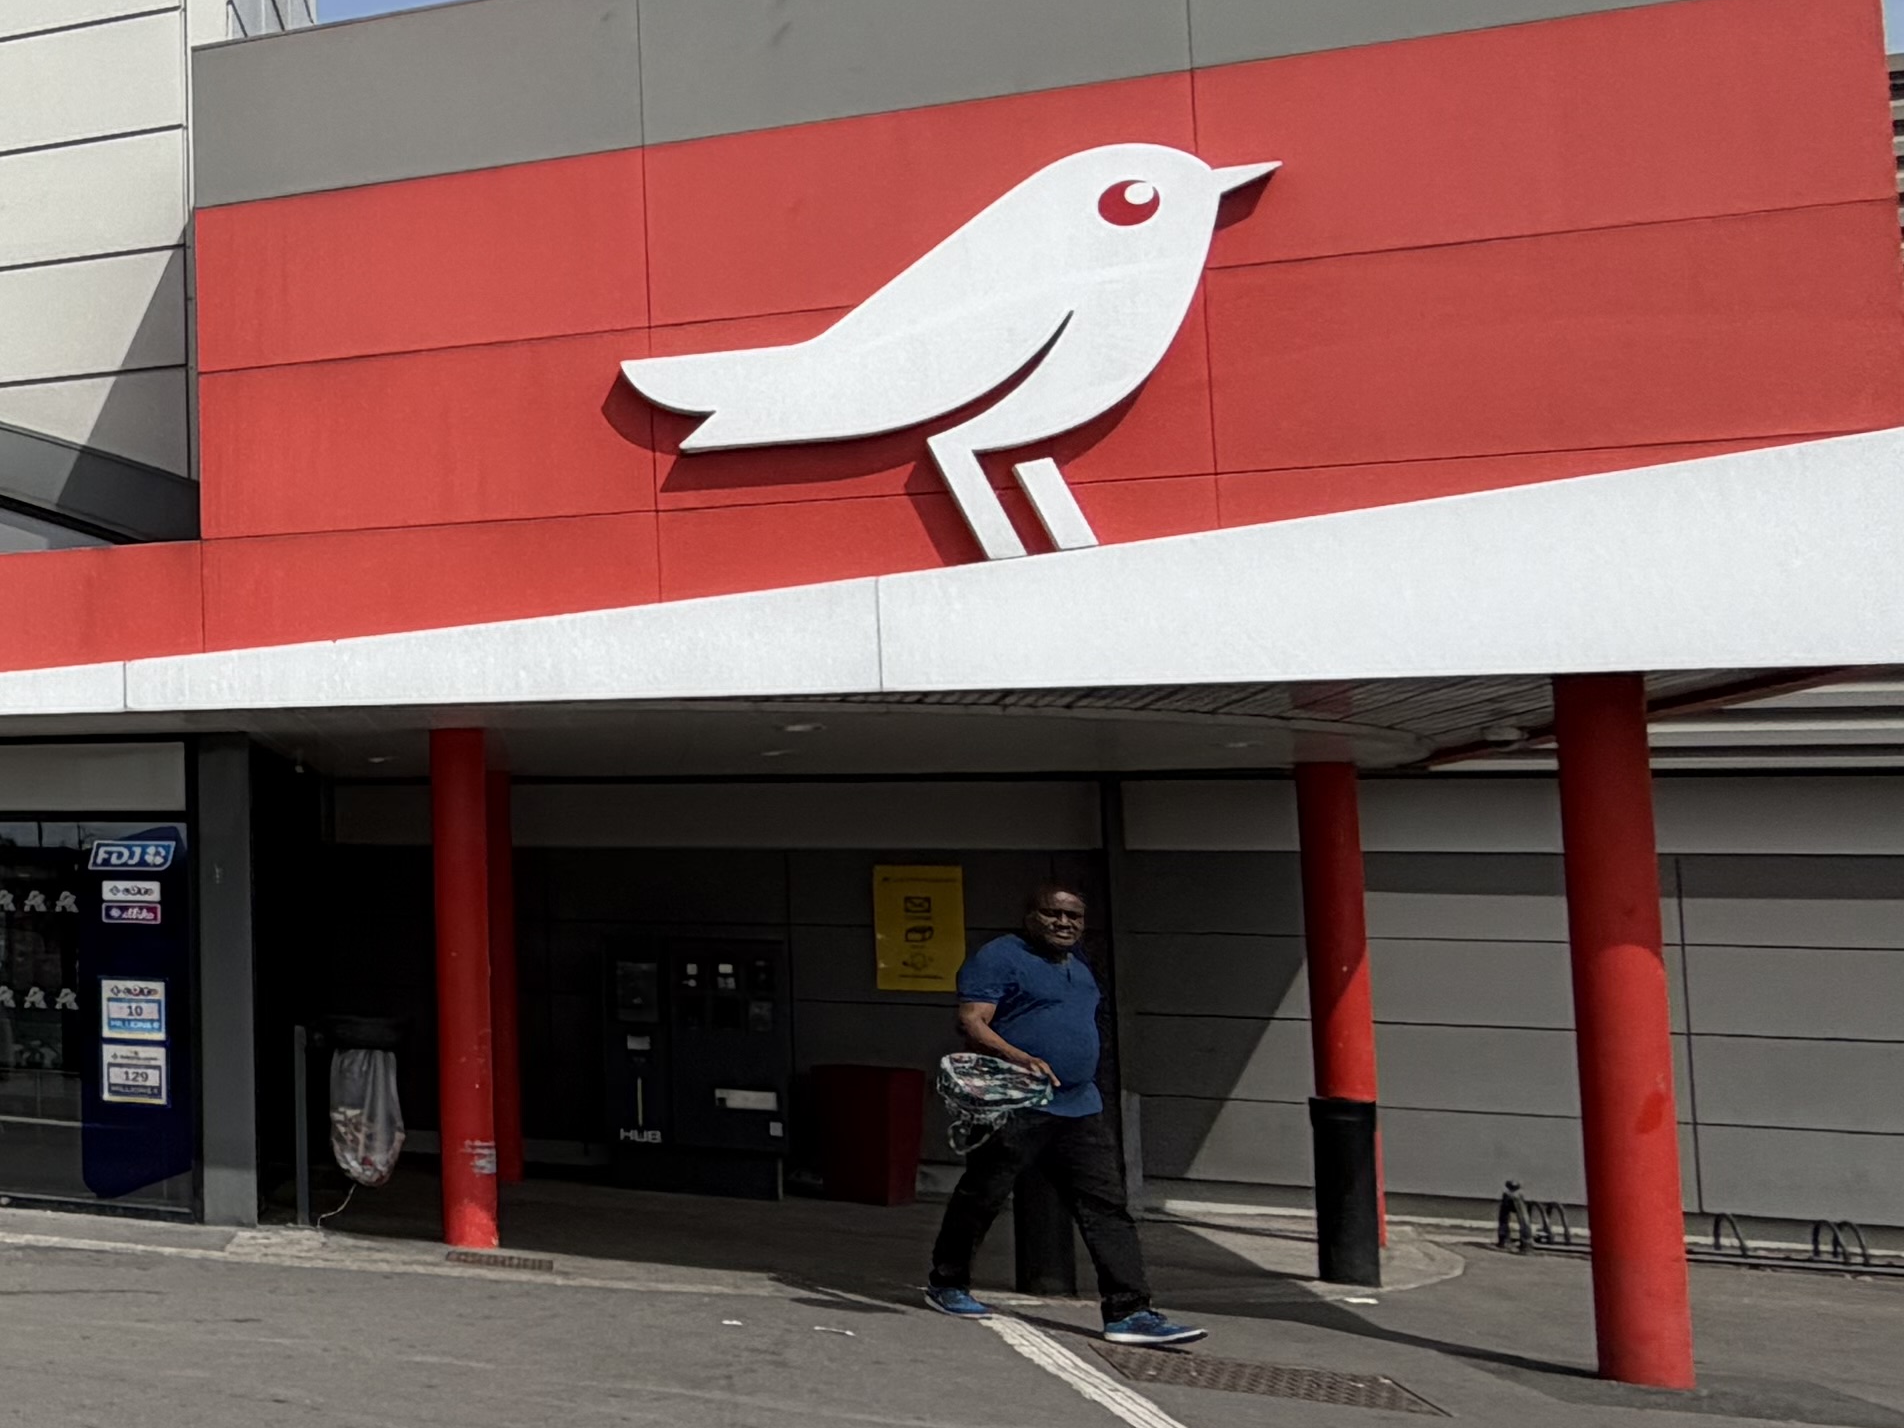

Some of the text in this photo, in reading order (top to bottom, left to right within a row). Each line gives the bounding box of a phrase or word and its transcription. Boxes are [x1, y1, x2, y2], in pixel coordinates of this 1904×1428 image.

[96, 846, 142, 865] FDJ
[127, 1005, 143, 1017] 10
[124, 1070, 149, 1082] 129
[620, 1128, 662, 1143] HUB
